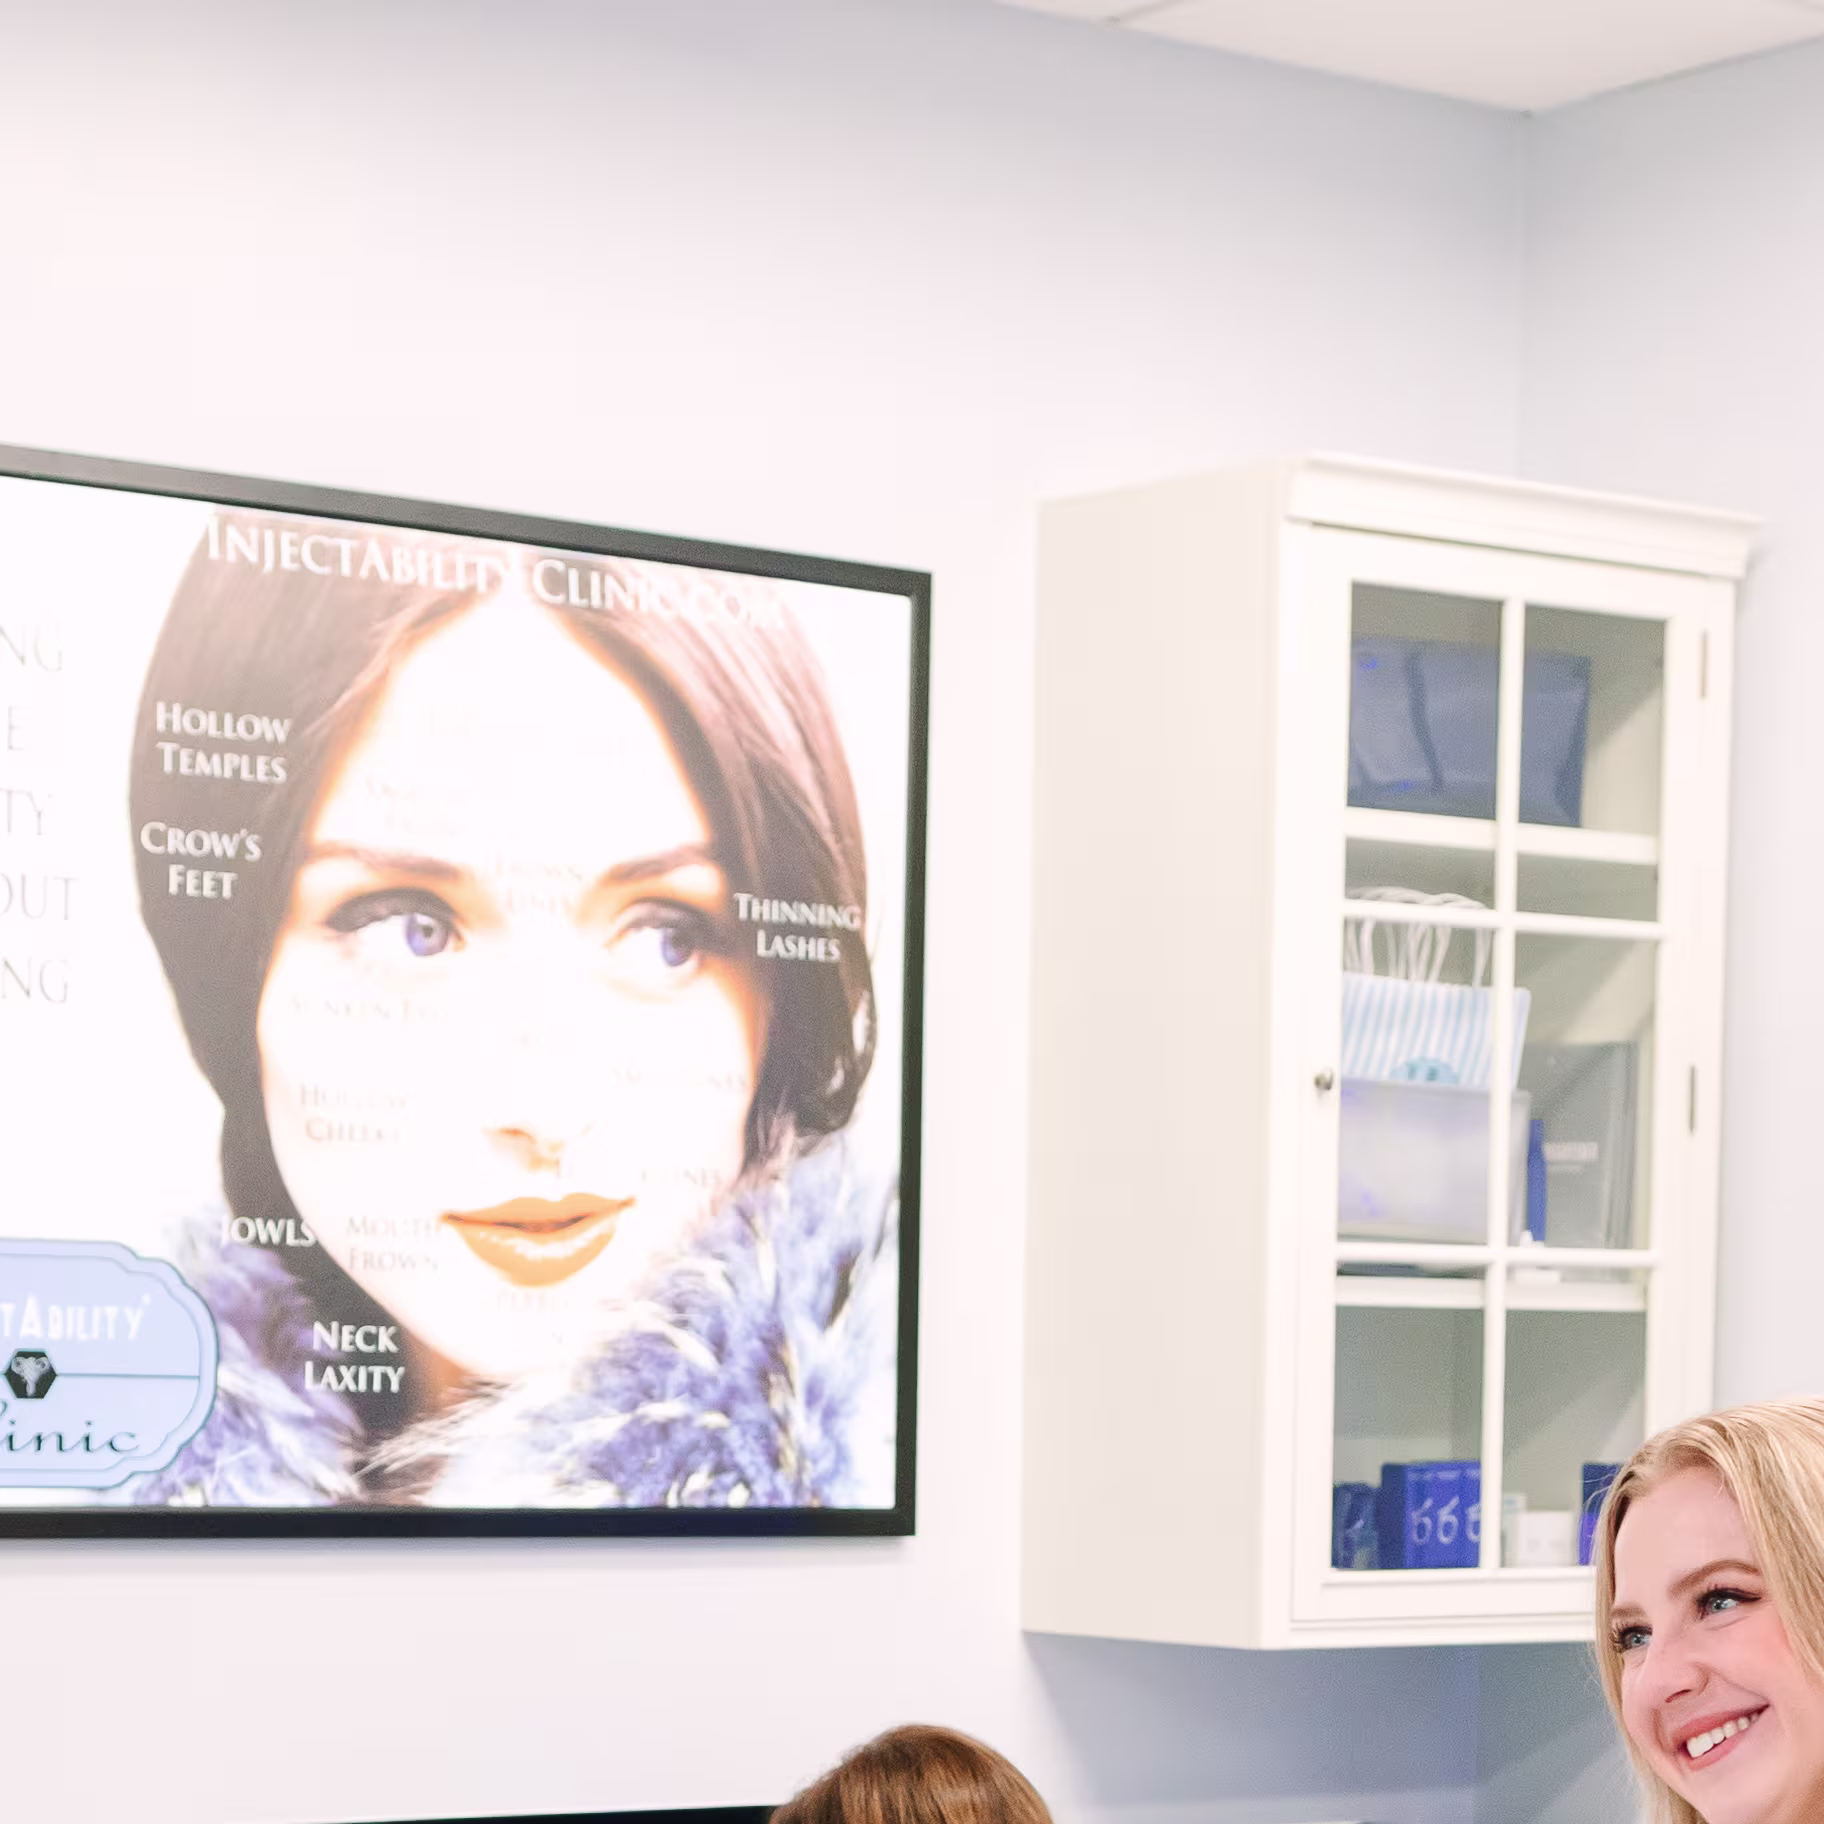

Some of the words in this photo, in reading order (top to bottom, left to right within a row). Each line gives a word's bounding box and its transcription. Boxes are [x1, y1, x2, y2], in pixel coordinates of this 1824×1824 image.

[155, 701, 292, 744] HOLLOW
[156, 741, 288, 784] TEMPLES
[140, 821, 263, 862] CROW'S
[168, 864, 238, 899] FEET
[733, 892, 862, 931] THINNING
[757, 929, 841, 962] LASHES
[312, 1320, 399, 1353] NECK
[304, 1360, 405, 1393] LAXITY
